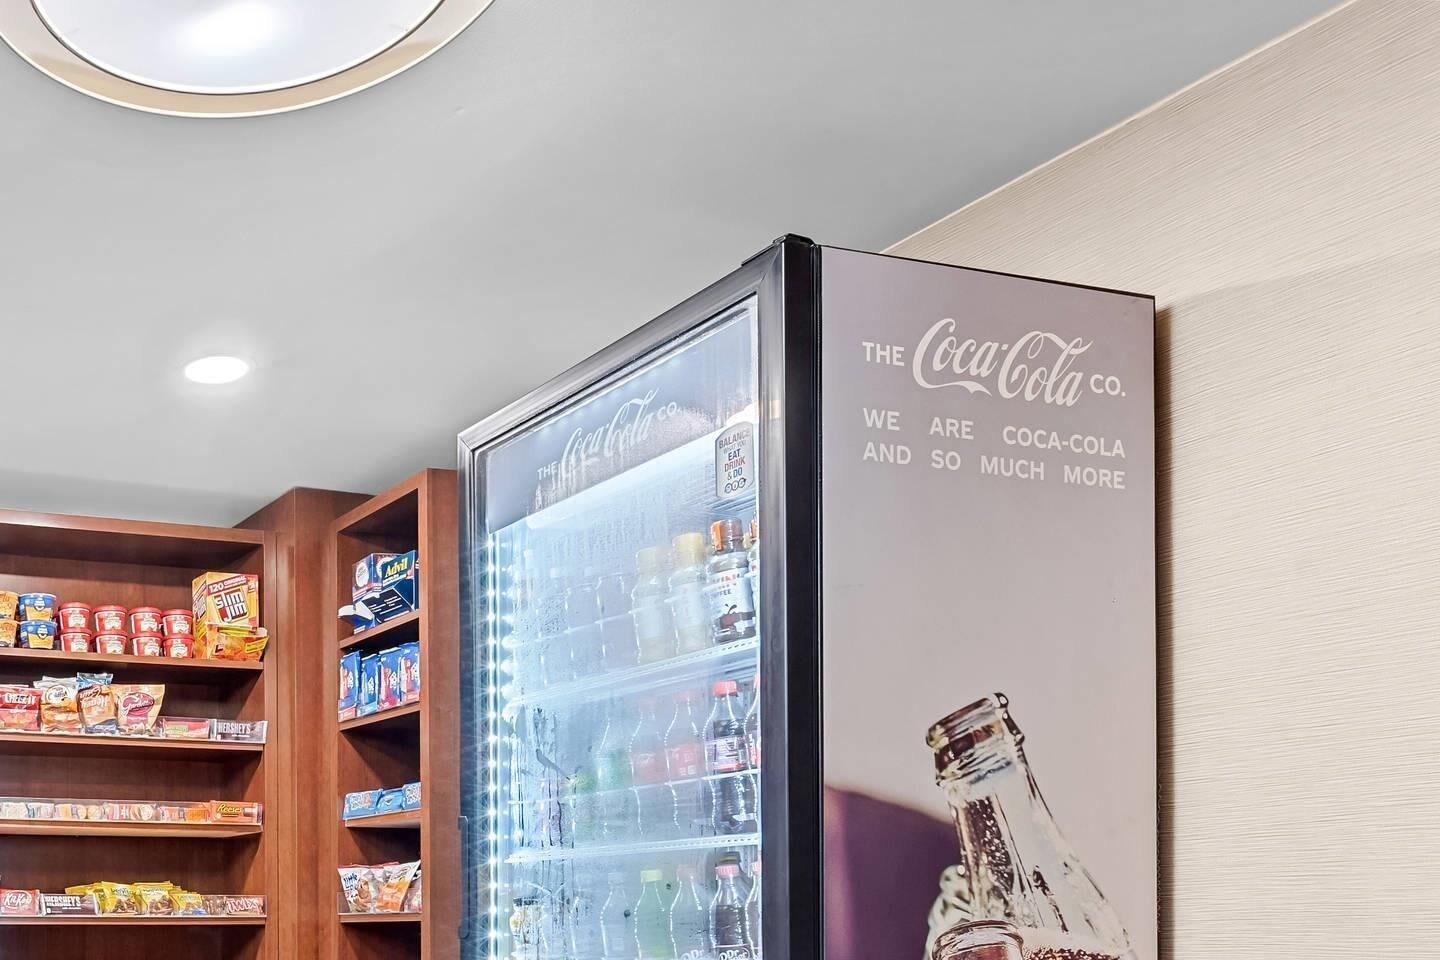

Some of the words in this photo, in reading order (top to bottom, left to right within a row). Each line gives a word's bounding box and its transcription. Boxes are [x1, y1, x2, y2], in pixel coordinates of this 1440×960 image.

[862, 341, 905, 367] THE
[912, 317, 1093, 407] Coca-Cola
[1089, 373, 1127, 397] CO.
[862, 406, 901, 431] WE
[929, 416, 975, 440] ARE
[1002, 425, 1126, 459] COCA-COLA
[724, 456, 746, 473] DRINK
[728, 448, 741, 461] EAT
[862, 441, 911, 466] AND
[931, 449, 961, 471] SO
[980, 455, 1045, 481] MUCH
[1063, 464, 1126, 490] MORE
[385, 557, 409, 578] Advil
